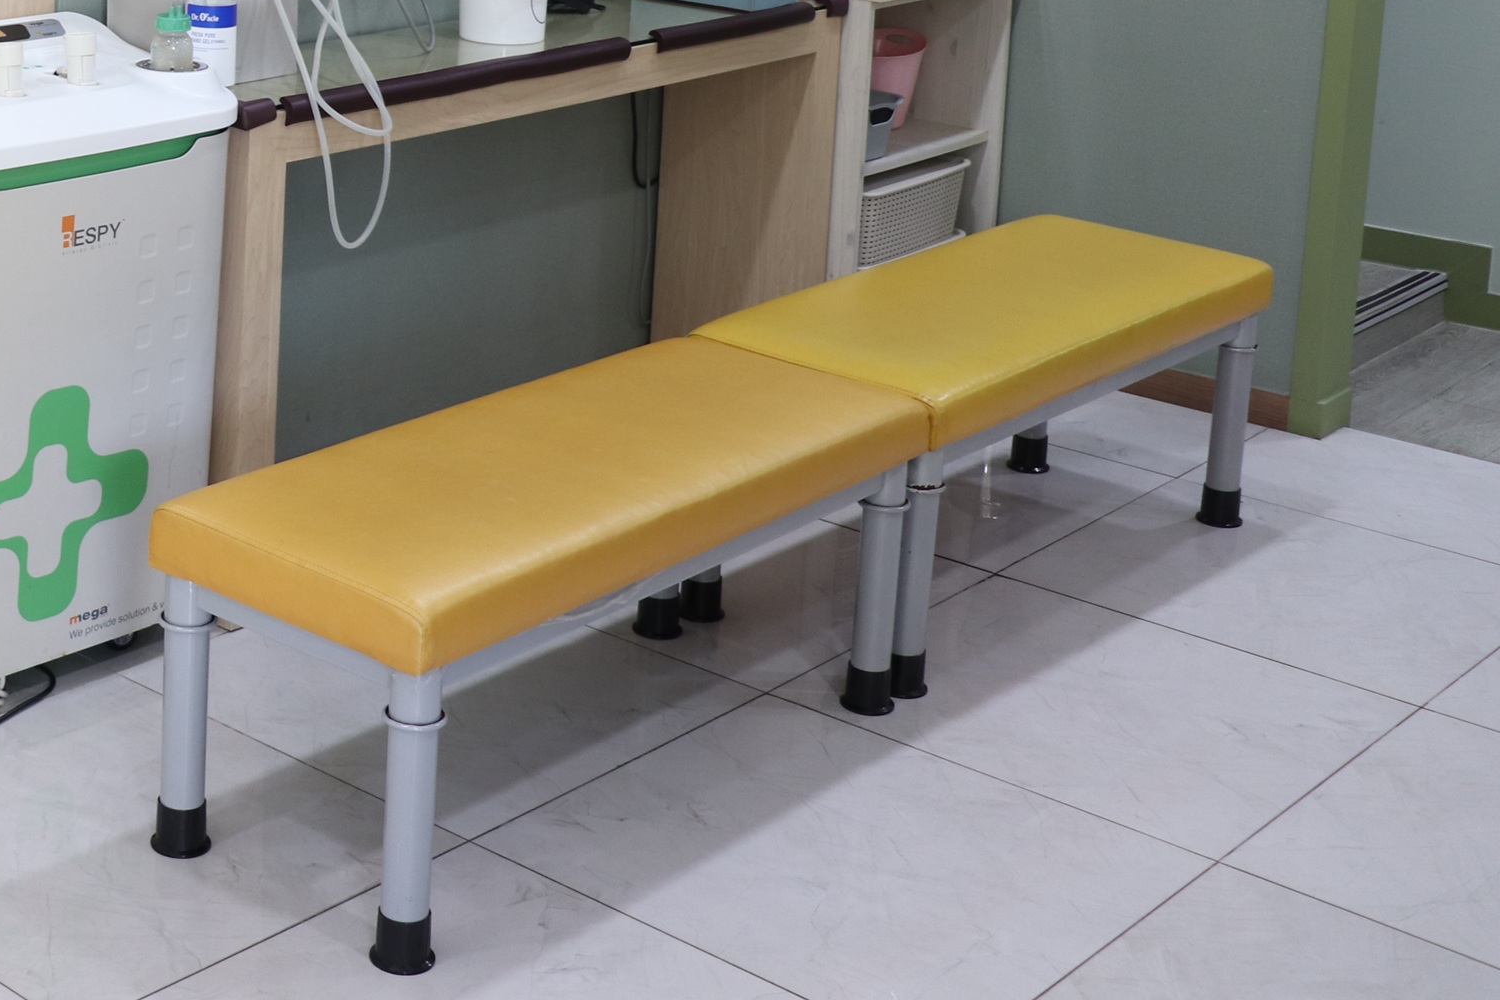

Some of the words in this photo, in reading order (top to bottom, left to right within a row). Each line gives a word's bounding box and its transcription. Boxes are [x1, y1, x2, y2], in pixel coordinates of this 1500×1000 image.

[62, 215, 121, 248] RESPY
[69, 605, 108, 625] mega
[69, 629, 83, 639] We
[85, 618, 116, 636] provide
[118, 606, 150, 624] solution
[152, 603, 158, 611] &
